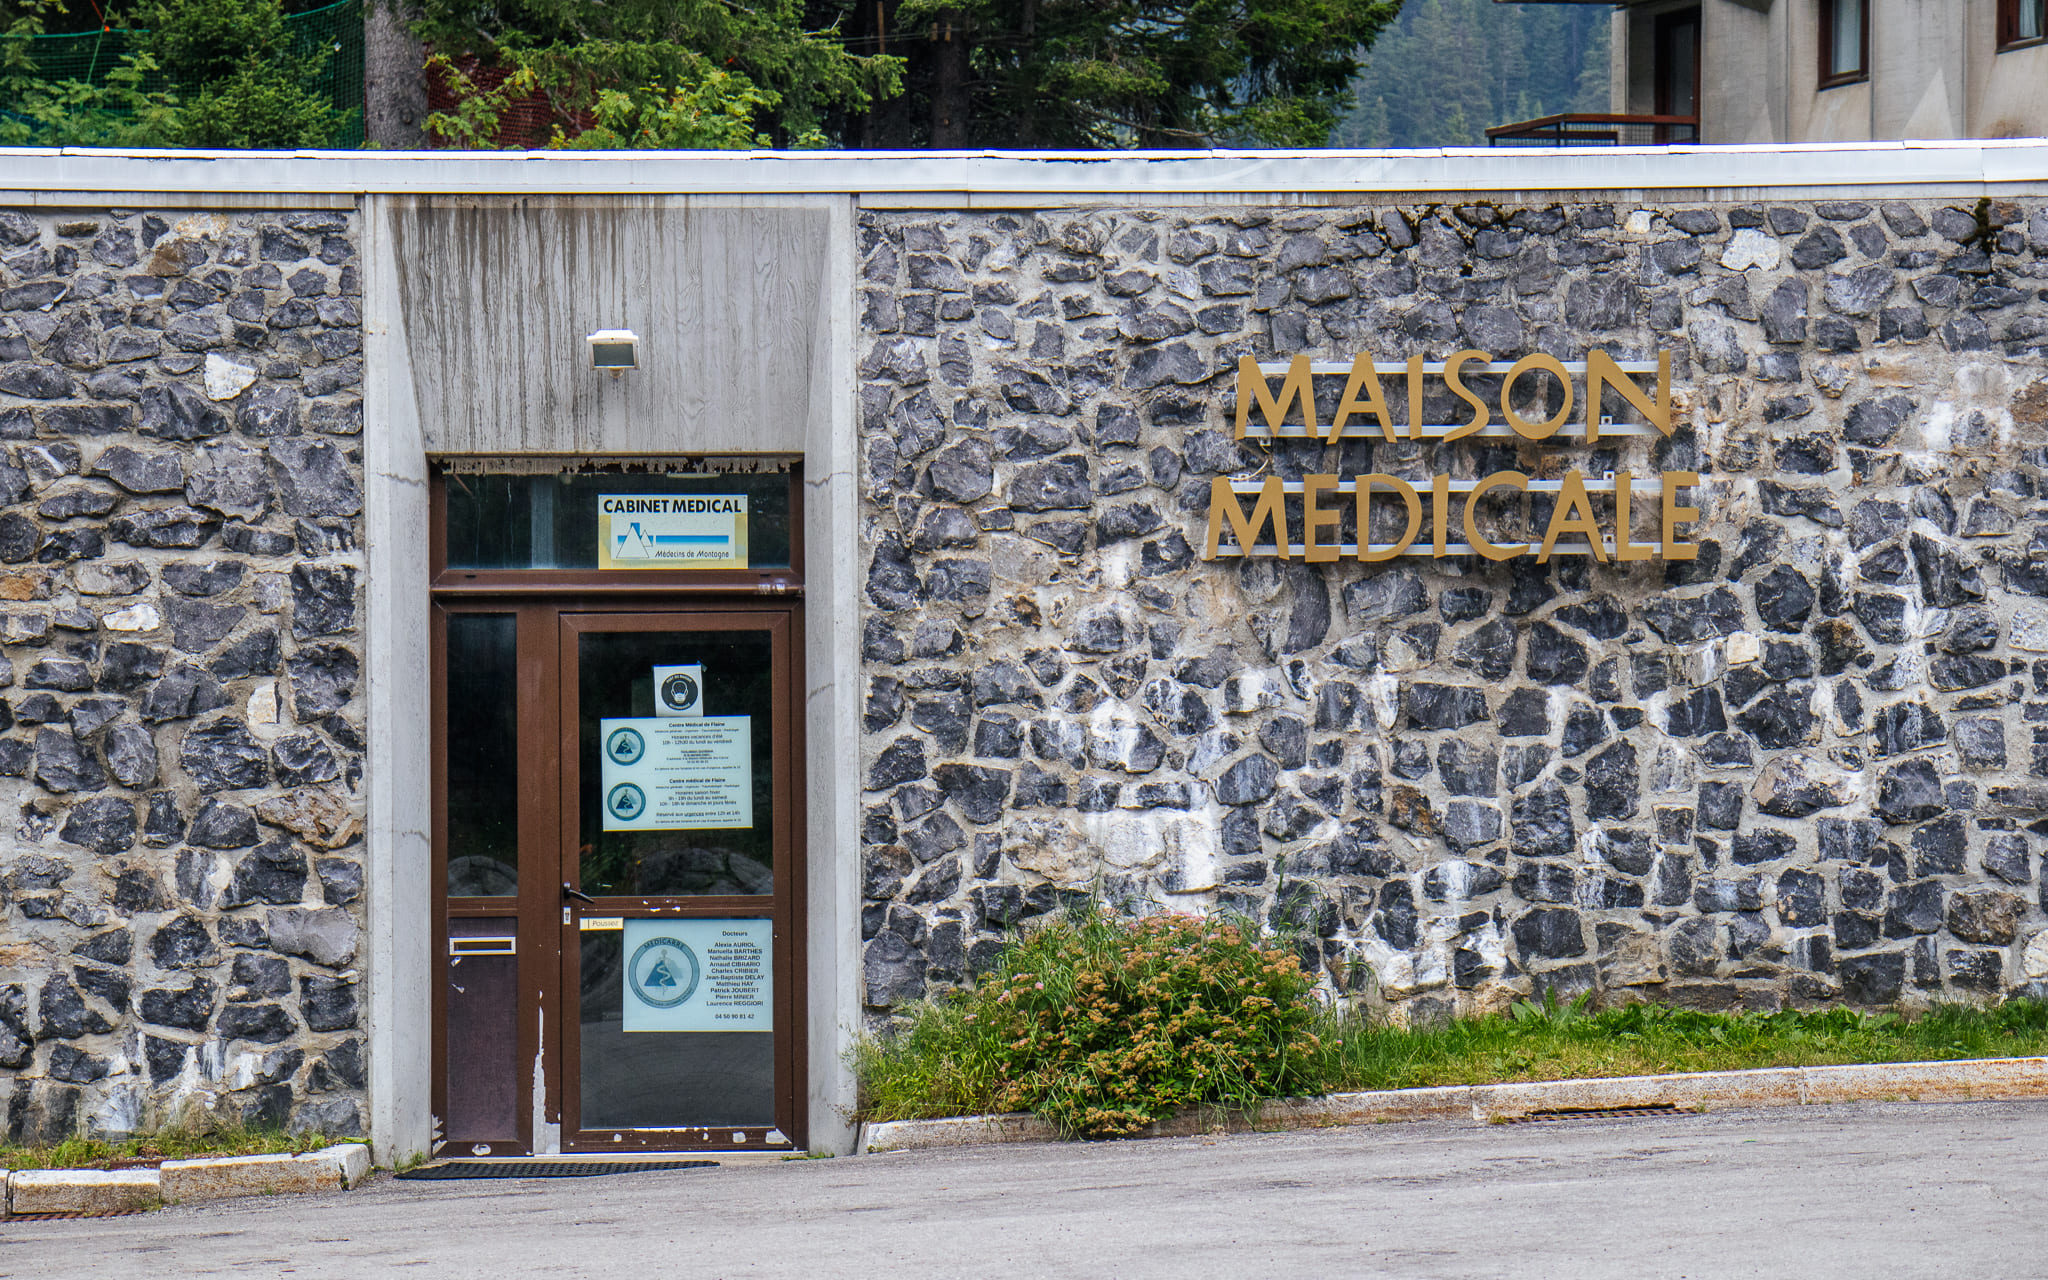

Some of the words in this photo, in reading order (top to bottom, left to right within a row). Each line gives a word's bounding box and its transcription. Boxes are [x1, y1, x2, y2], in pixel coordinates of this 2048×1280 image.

[1234, 349, 1671, 444] MAISON
[604, 499, 669, 513] CABINET
[672, 499, 741, 513] MEDICAL
[1202, 470, 1700, 564] MEDICALE
[655, 550, 685, 558] Médecins
[686, 550, 694, 558] de
[696, 550, 729, 560] Montagne
